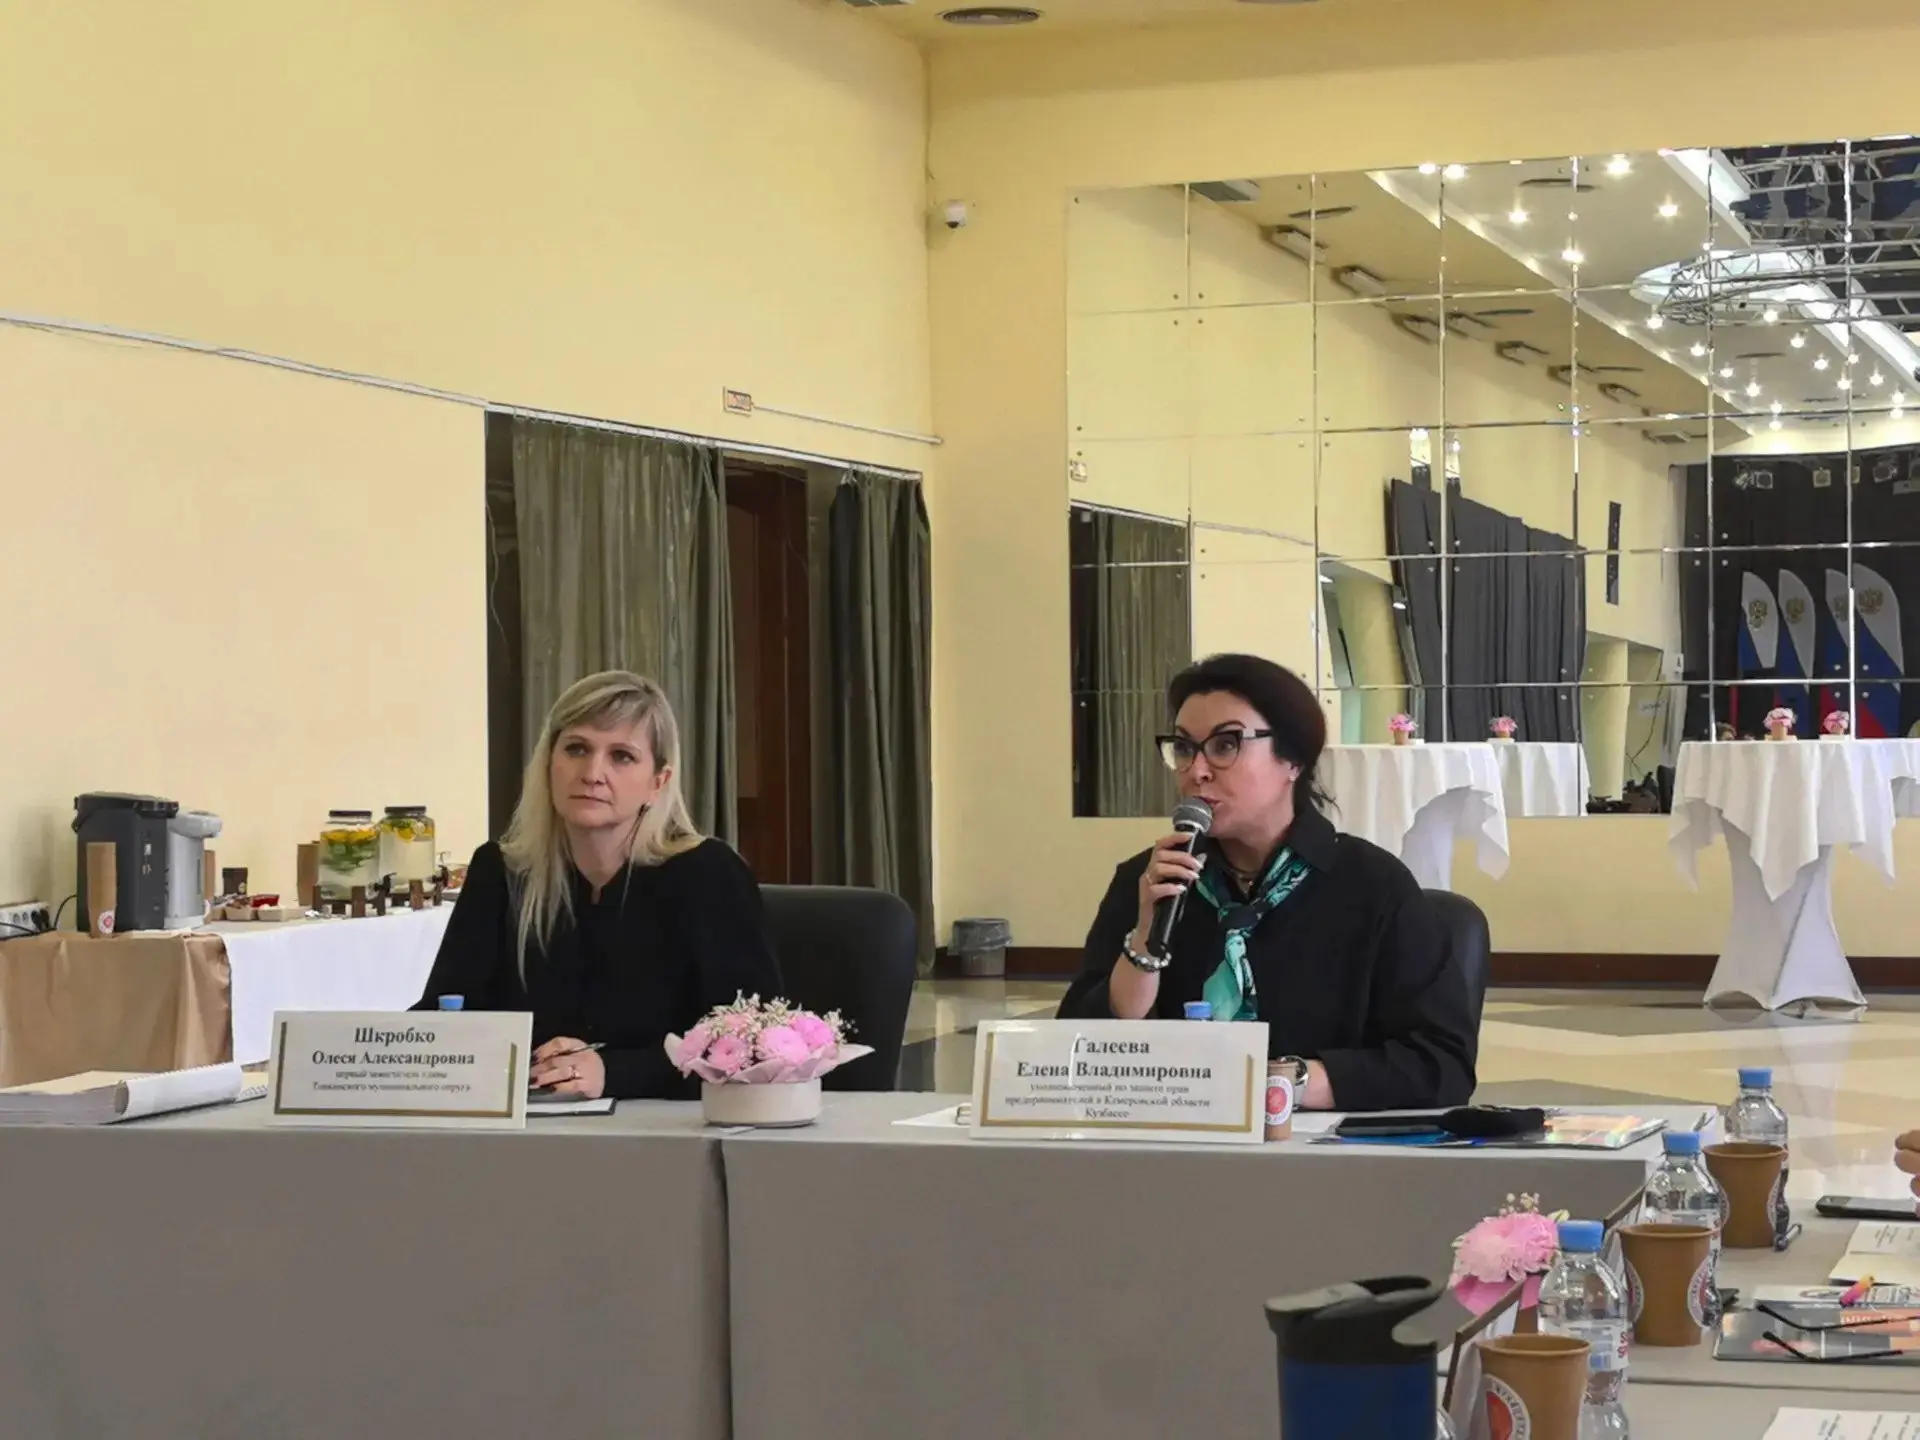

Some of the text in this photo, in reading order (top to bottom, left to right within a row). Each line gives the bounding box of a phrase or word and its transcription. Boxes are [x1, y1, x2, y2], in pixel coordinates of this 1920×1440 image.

[354, 1027, 436, 1046] Шкробко
[1074, 1037, 1151, 1054] Галеева
[312, 1050, 475, 1068] Олеся Александровна
[1016, 1061, 1212, 1081] Елена Владимировна
